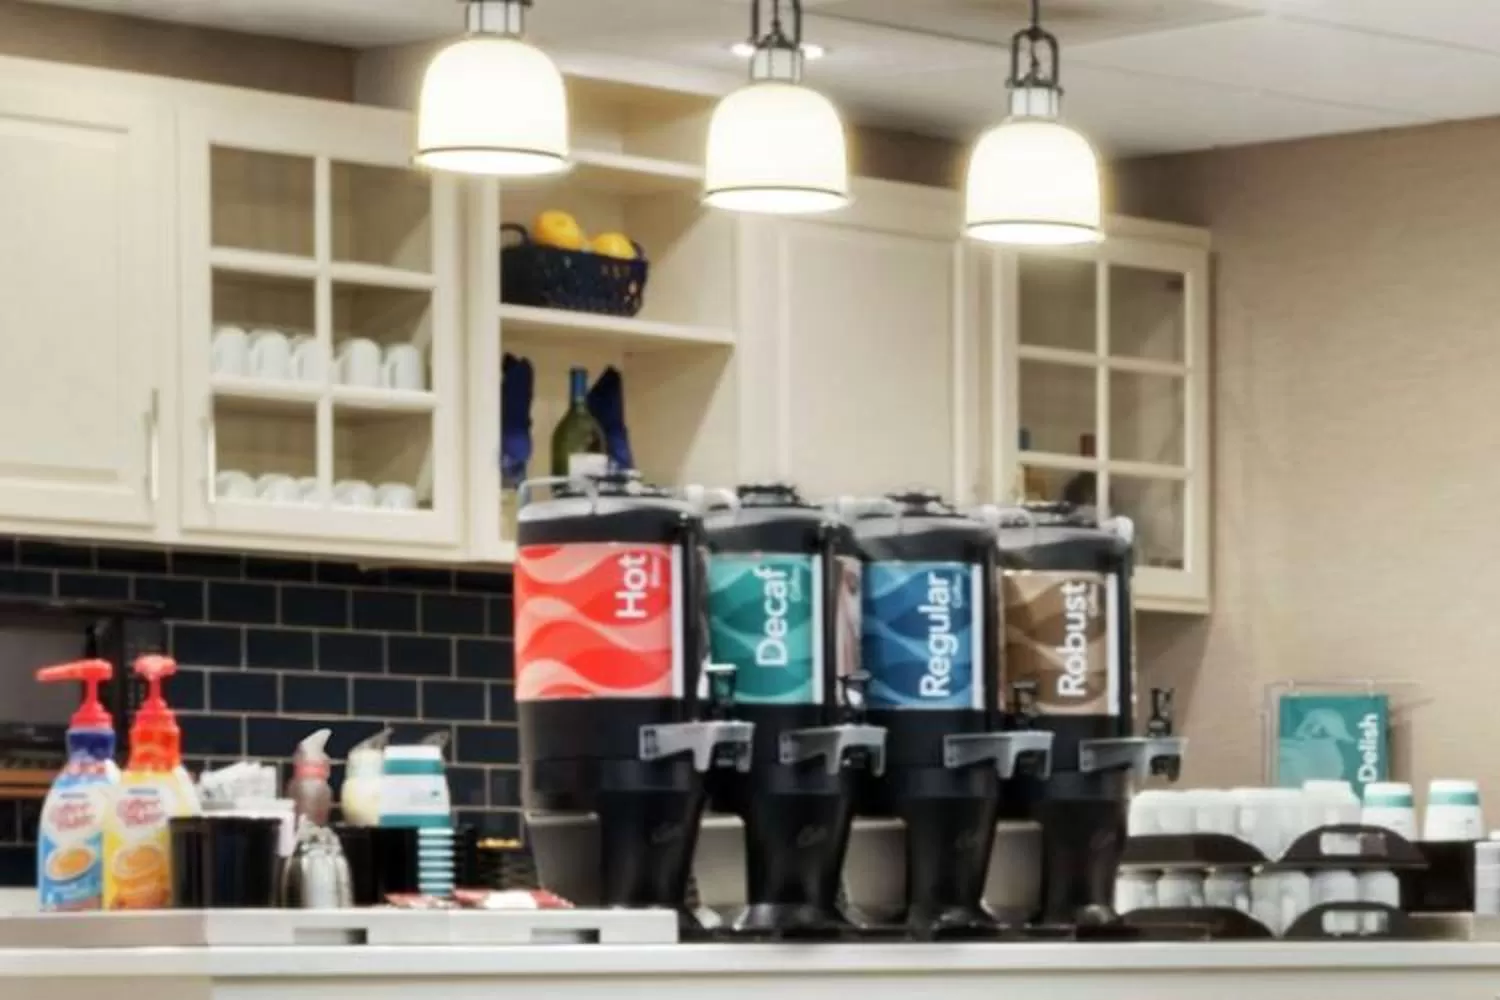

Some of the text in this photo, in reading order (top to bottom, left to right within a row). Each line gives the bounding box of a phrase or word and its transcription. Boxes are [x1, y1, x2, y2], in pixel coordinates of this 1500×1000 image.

[615, 553, 648, 618] Hot
[753, 566, 787, 666] Decaf
[918, 571, 959, 696] Regular
[1056, 582, 1087, 696] Robust
[1356, 712, 1378, 784] Delish
